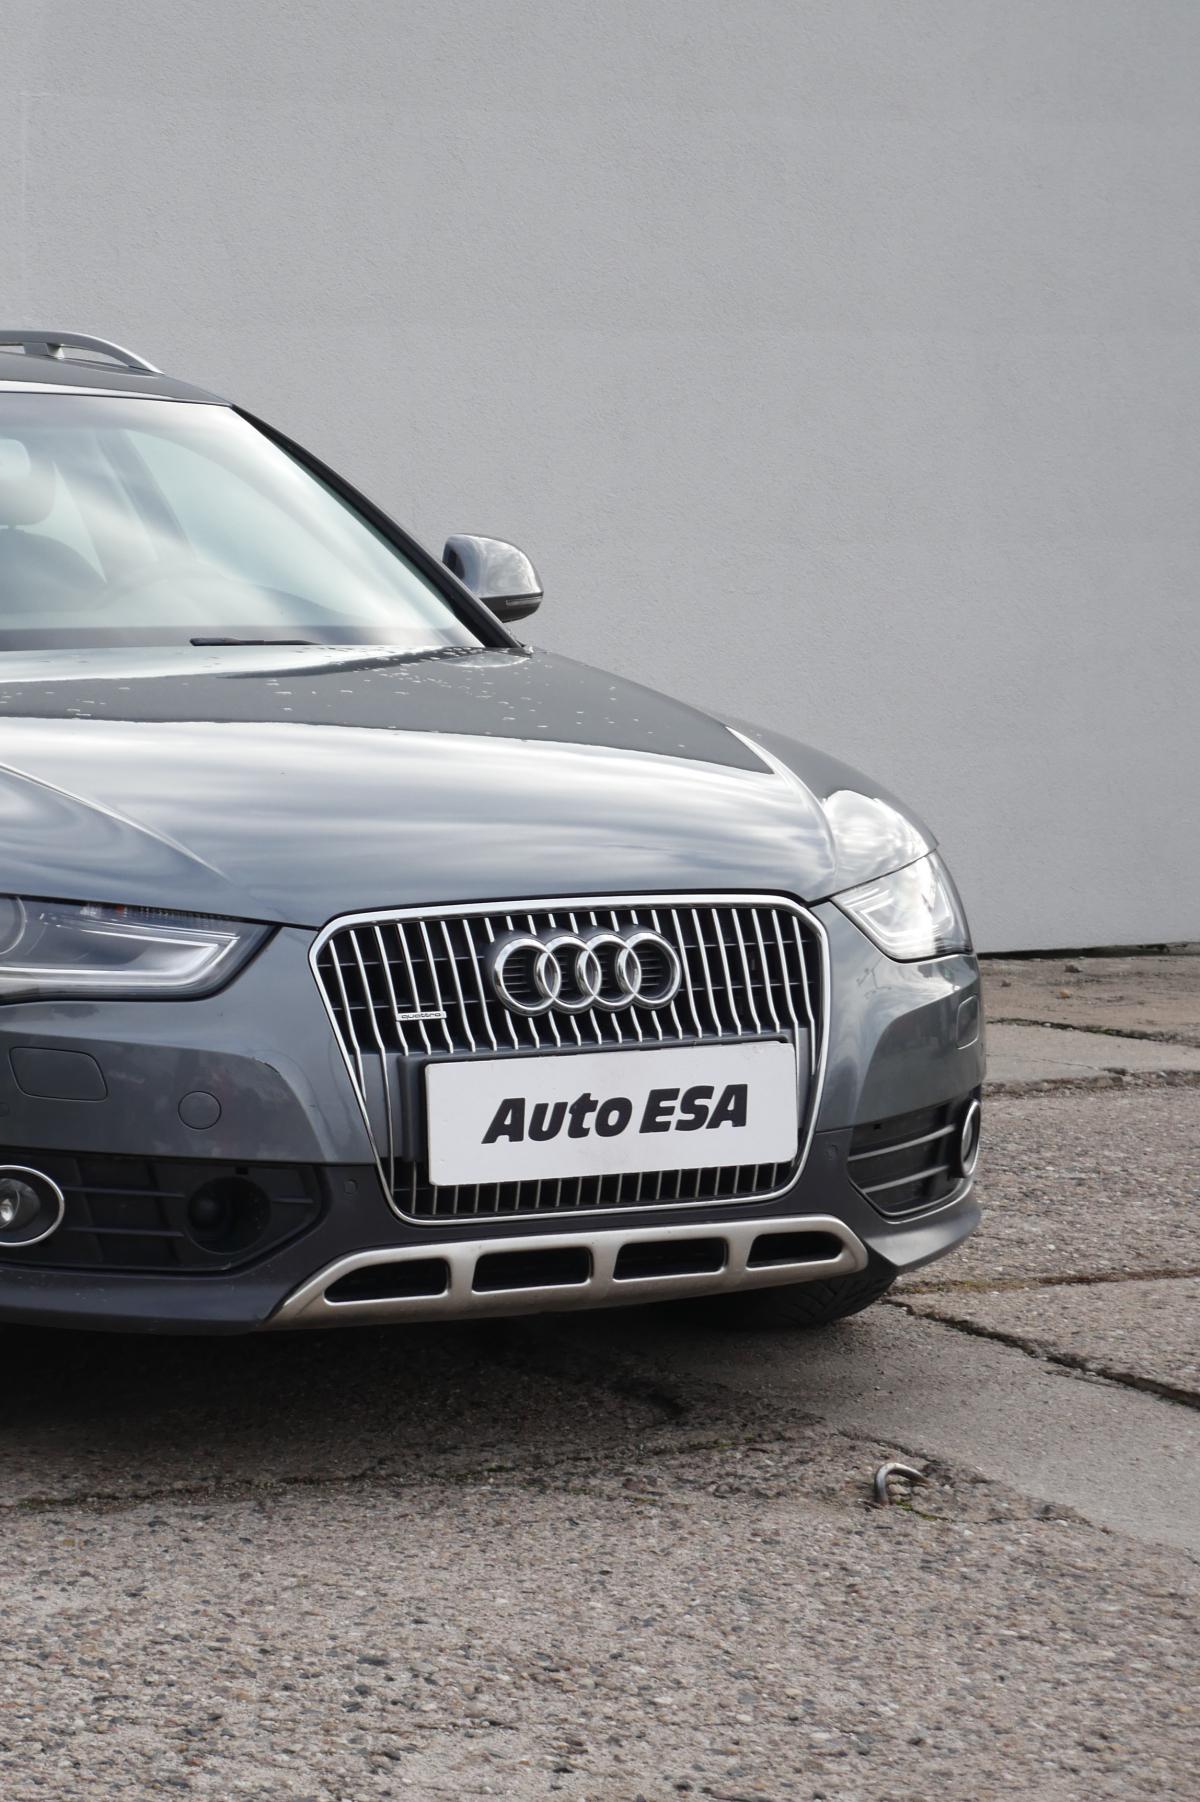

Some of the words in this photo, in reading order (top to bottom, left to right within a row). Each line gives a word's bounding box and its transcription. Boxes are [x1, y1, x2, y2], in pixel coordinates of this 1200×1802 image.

[401, 1012, 441, 1020] quattro
[481, 1092, 633, 1145] Auto
[638, 1083, 748, 1134] ESA
